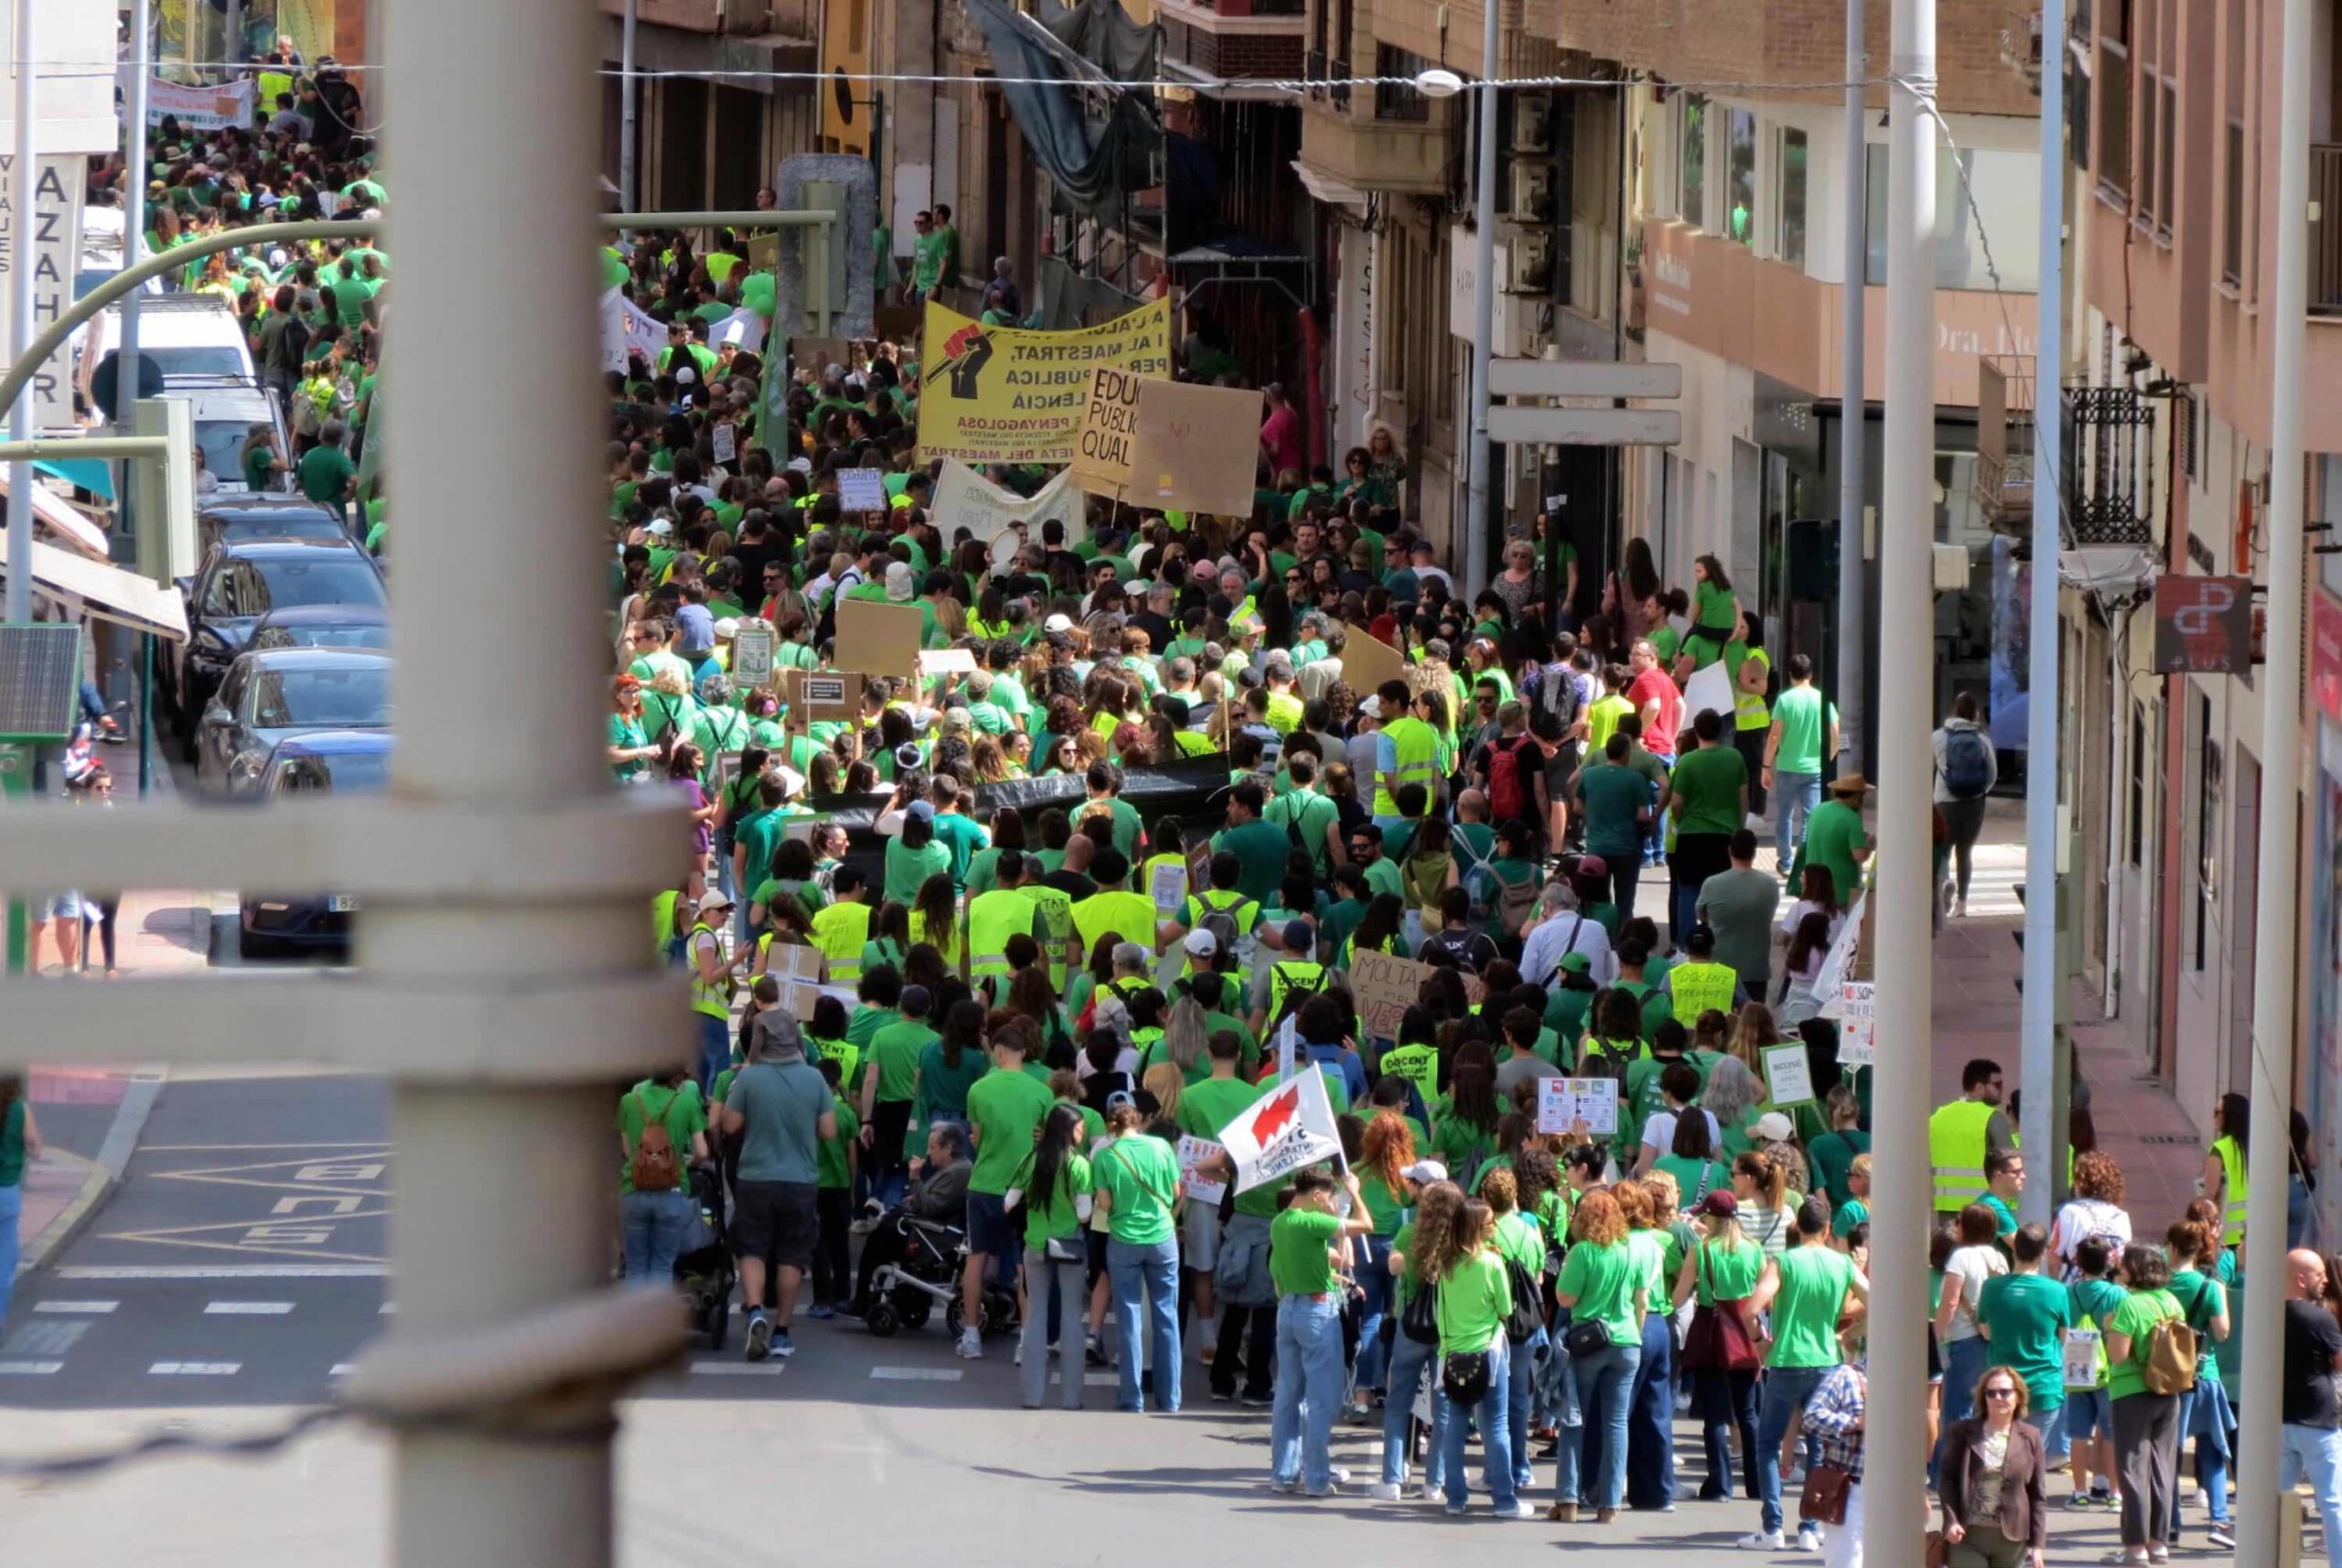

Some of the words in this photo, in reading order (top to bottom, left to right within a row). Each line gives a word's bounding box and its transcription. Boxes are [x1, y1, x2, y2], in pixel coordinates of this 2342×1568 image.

[34, 166, 68, 403] AZAHR
[1093, 368, 1139, 406] EDU
[1081, 428, 1131, 467] QUAL
[1277, 976, 1319, 986] DCENT
[1355, 956, 1418, 991] MOLTA
[1386, 1055, 1428, 1069] DOCENT
